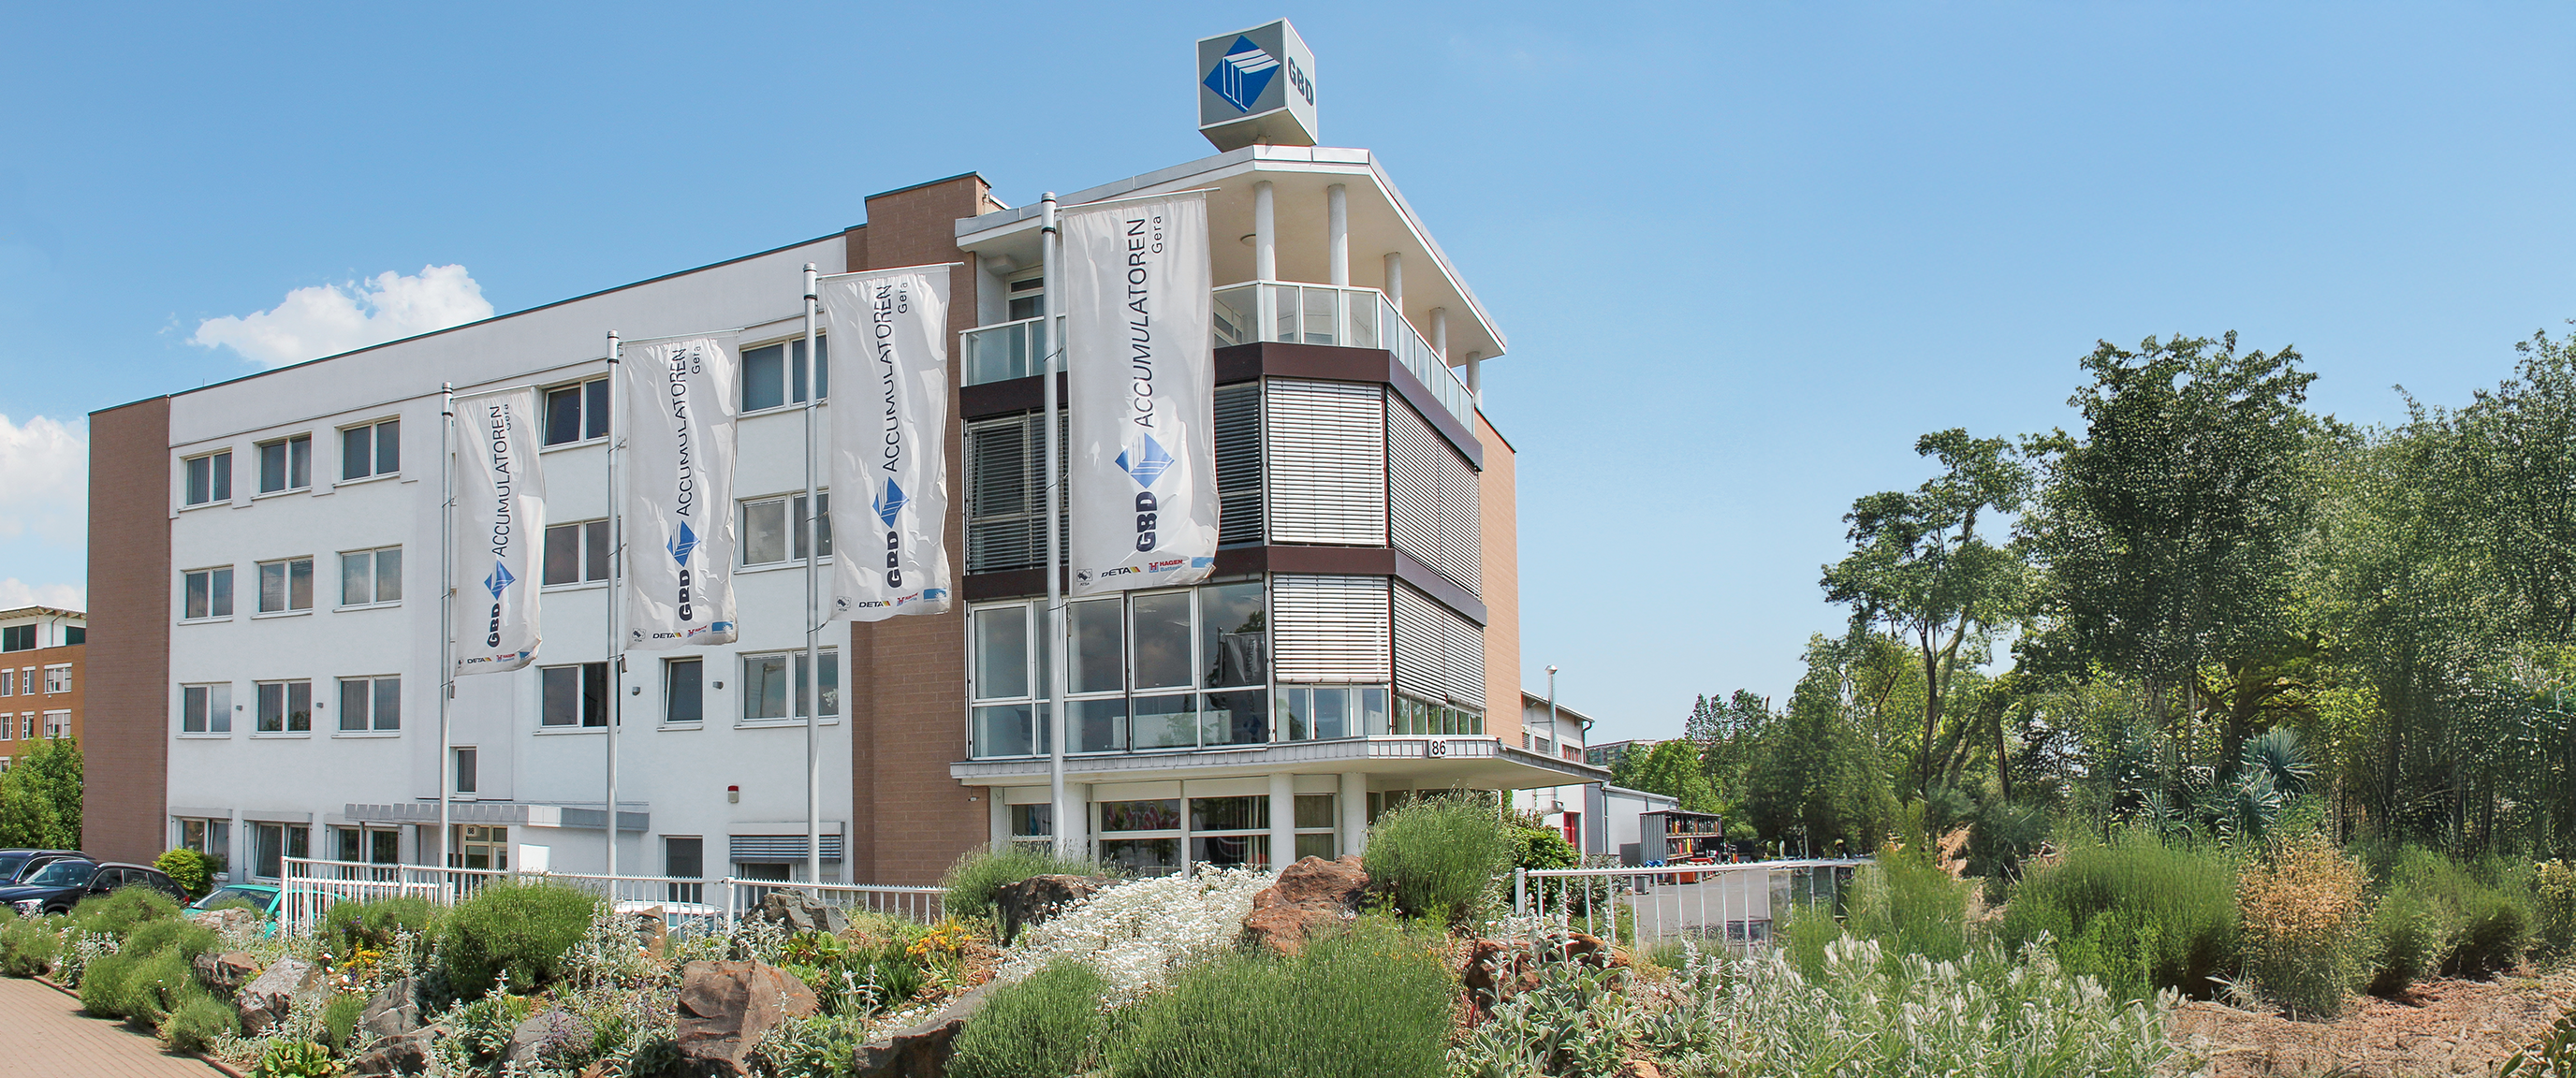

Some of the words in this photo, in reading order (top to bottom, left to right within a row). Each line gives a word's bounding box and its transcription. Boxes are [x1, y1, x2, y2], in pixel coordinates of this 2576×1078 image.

[1288, 56, 1314, 107] GBD
[1151, 215, 1163, 254] Gera
[898, 282, 908, 314] Gera
[1126, 218, 1154, 429] ACCUMULATOREN
[692, 345, 701, 375] Gera
[873, 284, 900, 473] ACCUMULATOREN
[669, 348, 693, 517] ACCUMULATOREN
[490, 405, 511, 558] ACCUMULATOREN
[1135, 491, 1158, 552] GBD
[1101, 567, 1132, 577] DETA
[1160, 559, 1183, 567] HAGEN
[487, 603, 501, 648] GBD
[1432, 740, 1446, 755] 86
[467, 826, 476, 835] 88
